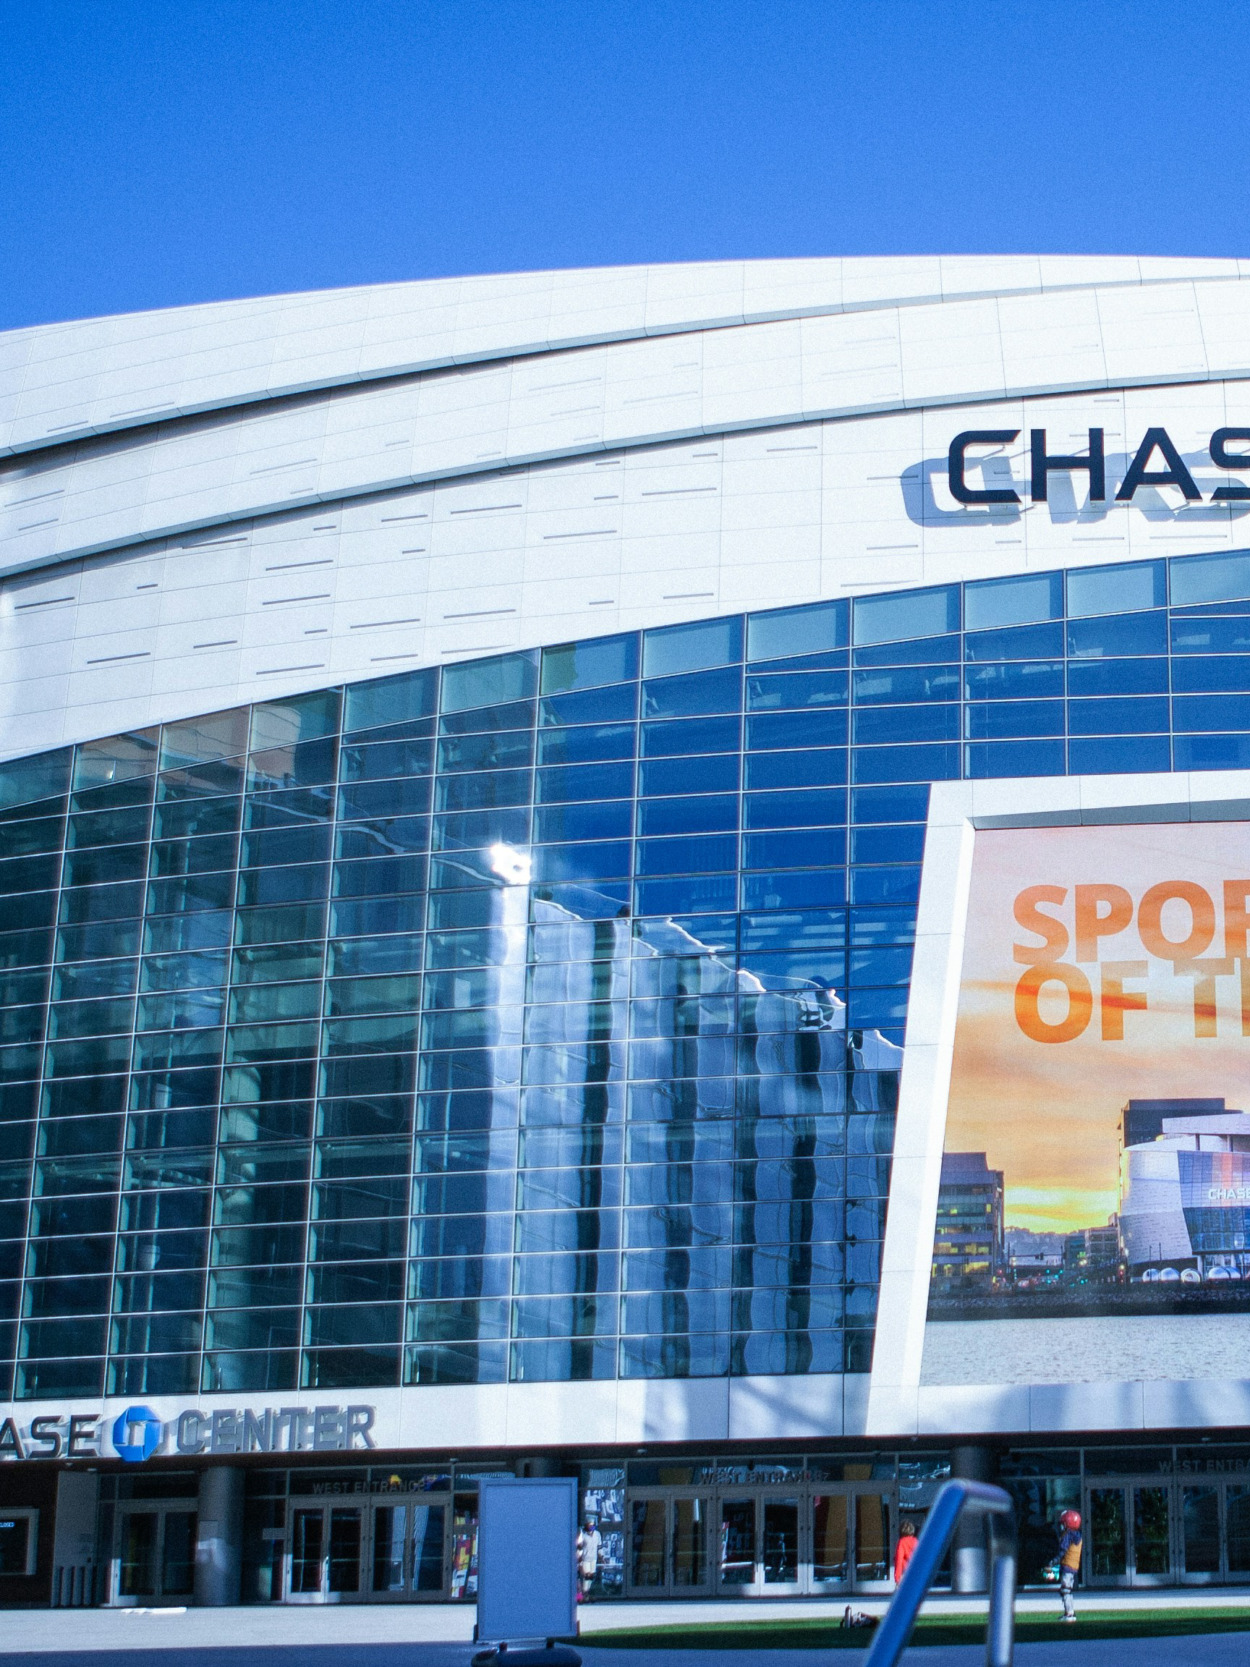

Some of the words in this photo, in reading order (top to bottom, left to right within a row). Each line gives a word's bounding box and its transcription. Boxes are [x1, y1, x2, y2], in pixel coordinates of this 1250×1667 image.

[1014, 960, 1148, 1043] OF
[176, 1404, 377, 1453] CENTER
[1159, 1460, 1201, 1473] WEST
[313, 1482, 350, 1494] WEST
[354, 1480, 425, 1494] ENTRANCE
